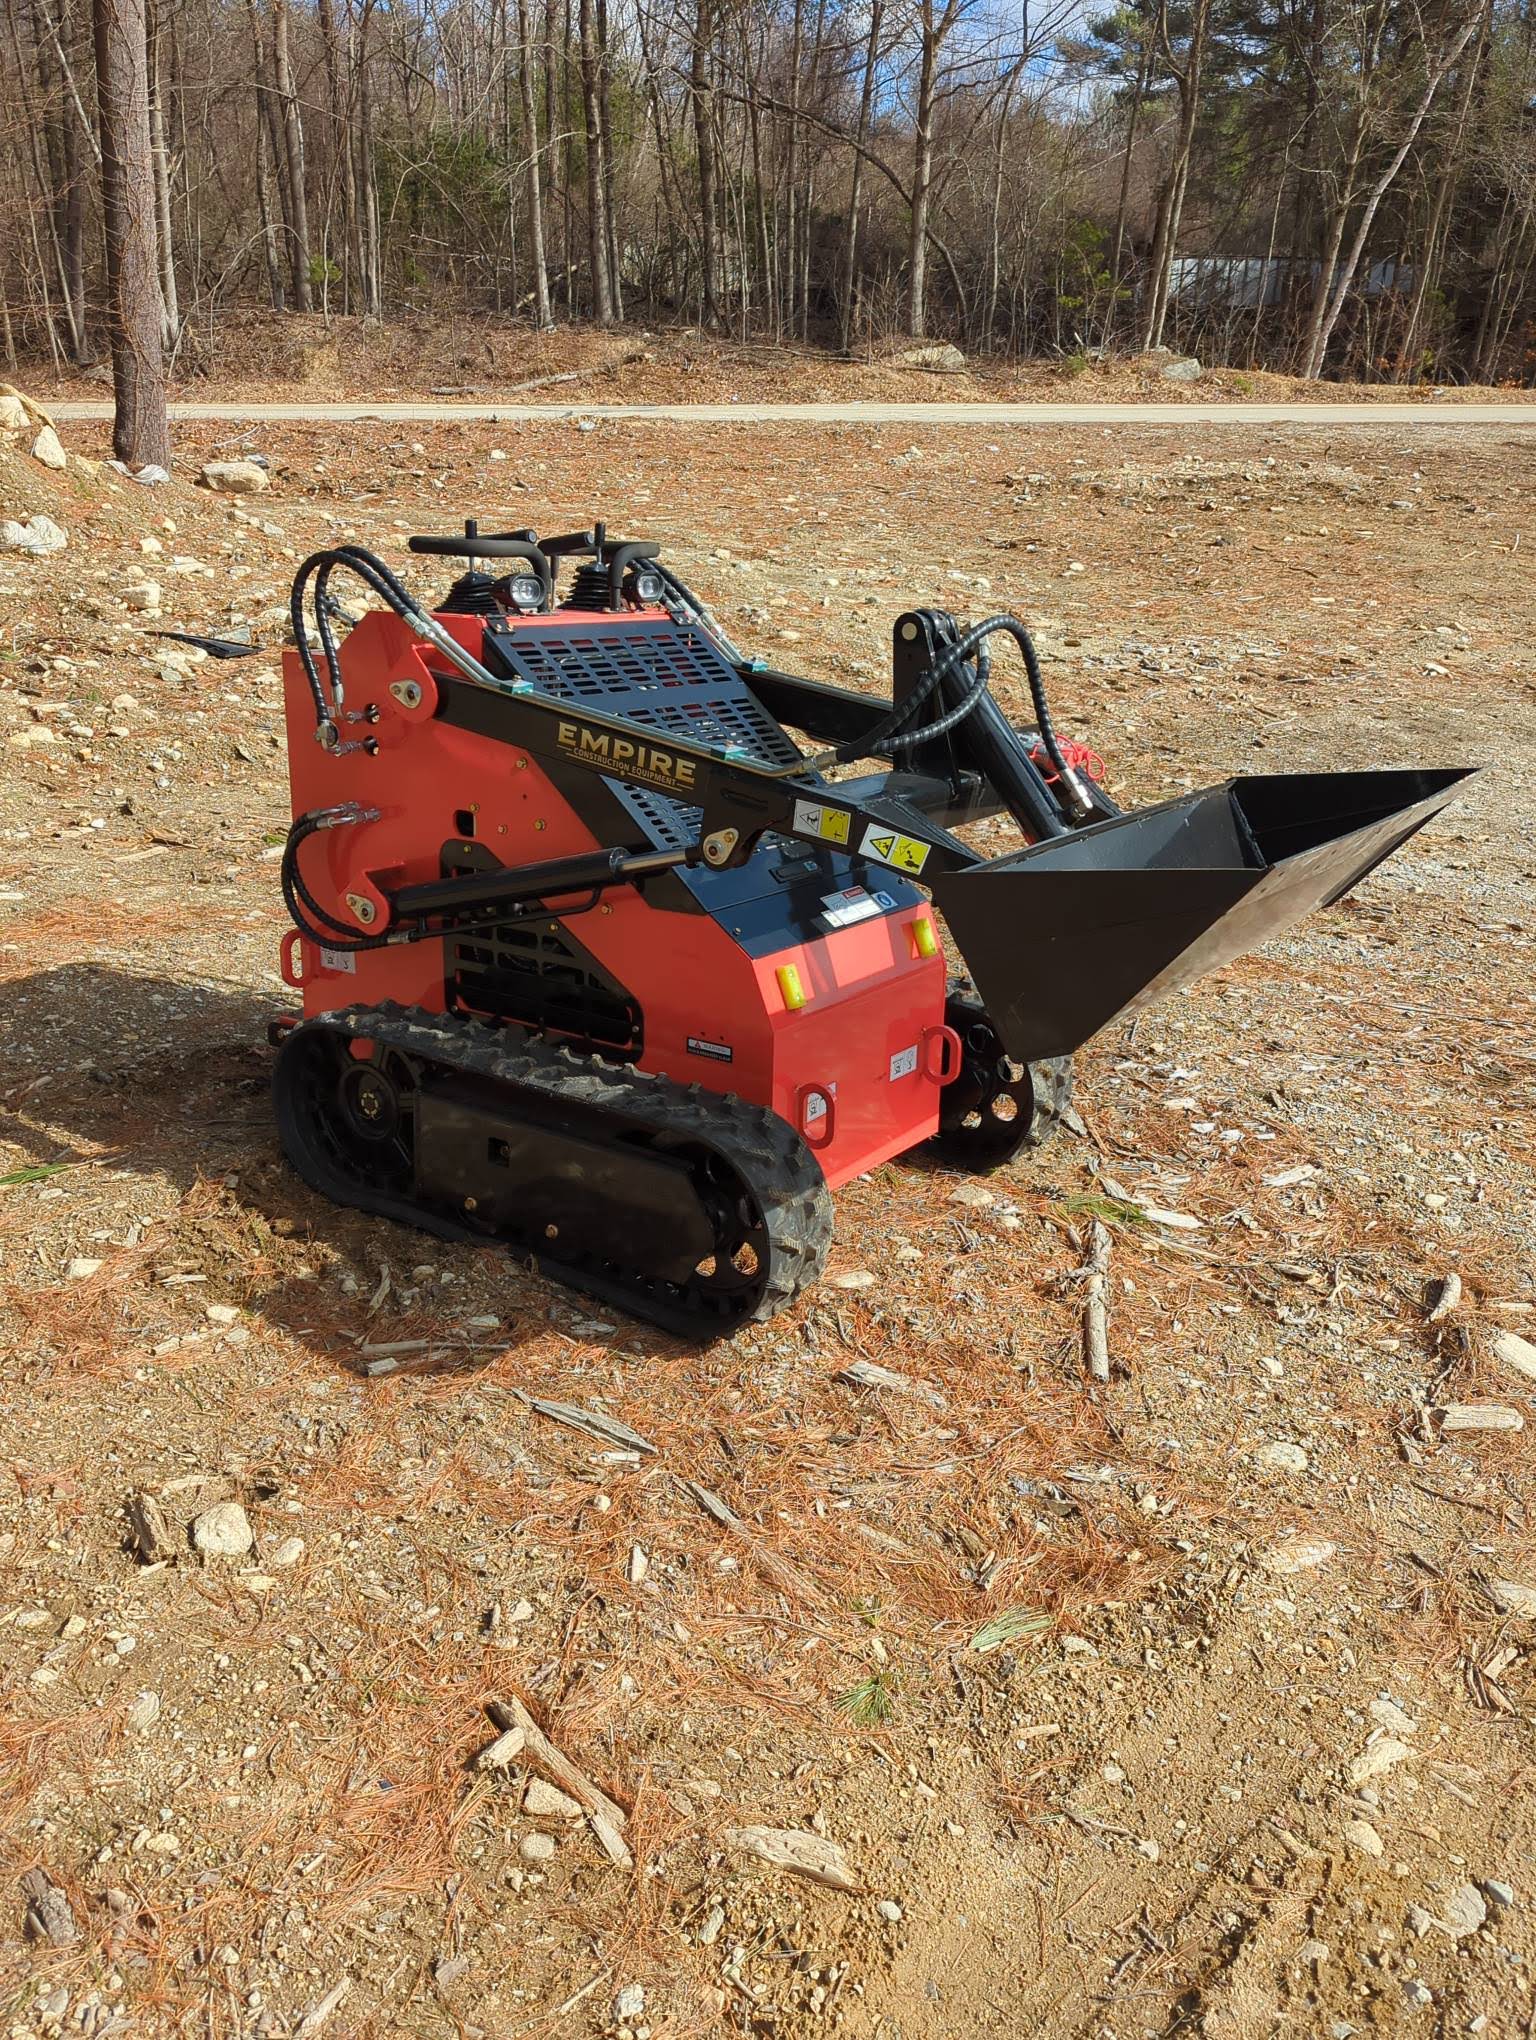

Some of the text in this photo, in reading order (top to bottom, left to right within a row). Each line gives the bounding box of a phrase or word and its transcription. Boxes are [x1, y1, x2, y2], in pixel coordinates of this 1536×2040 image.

[558, 722, 697, 784] EMPIRE
[573, 747, 676, 786] CONSTRUCTION EQUIPMENT
